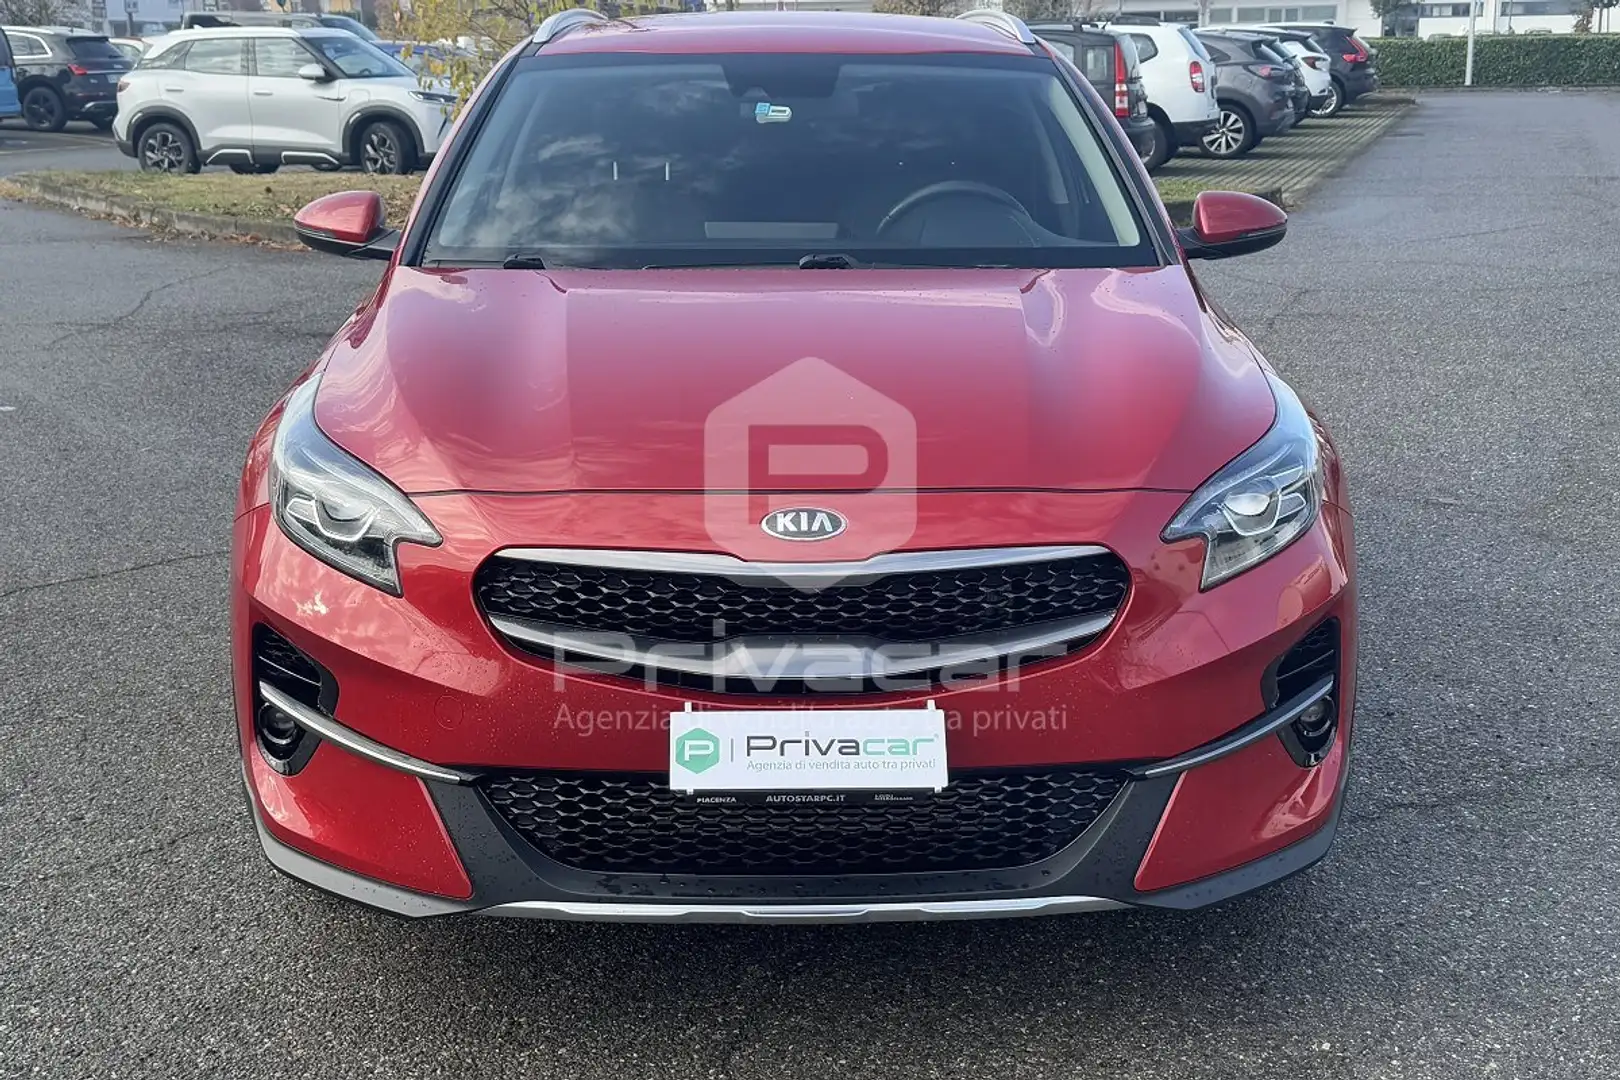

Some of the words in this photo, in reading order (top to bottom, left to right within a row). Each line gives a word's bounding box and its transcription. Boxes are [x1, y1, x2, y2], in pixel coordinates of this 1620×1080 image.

[776, 511, 833, 532] KIA
[746, 731, 935, 757] Privacar
[746, 760, 792, 772] Agenzia
[795, 759, 806, 770] di
[808, 759, 850, 770] vendita
[853, 760, 880, 770] auto
[882, 760, 897, 770] tra
[900, 758, 936, 771] privati
[765, 794, 846, 803] AUTOSTARPC.IT
